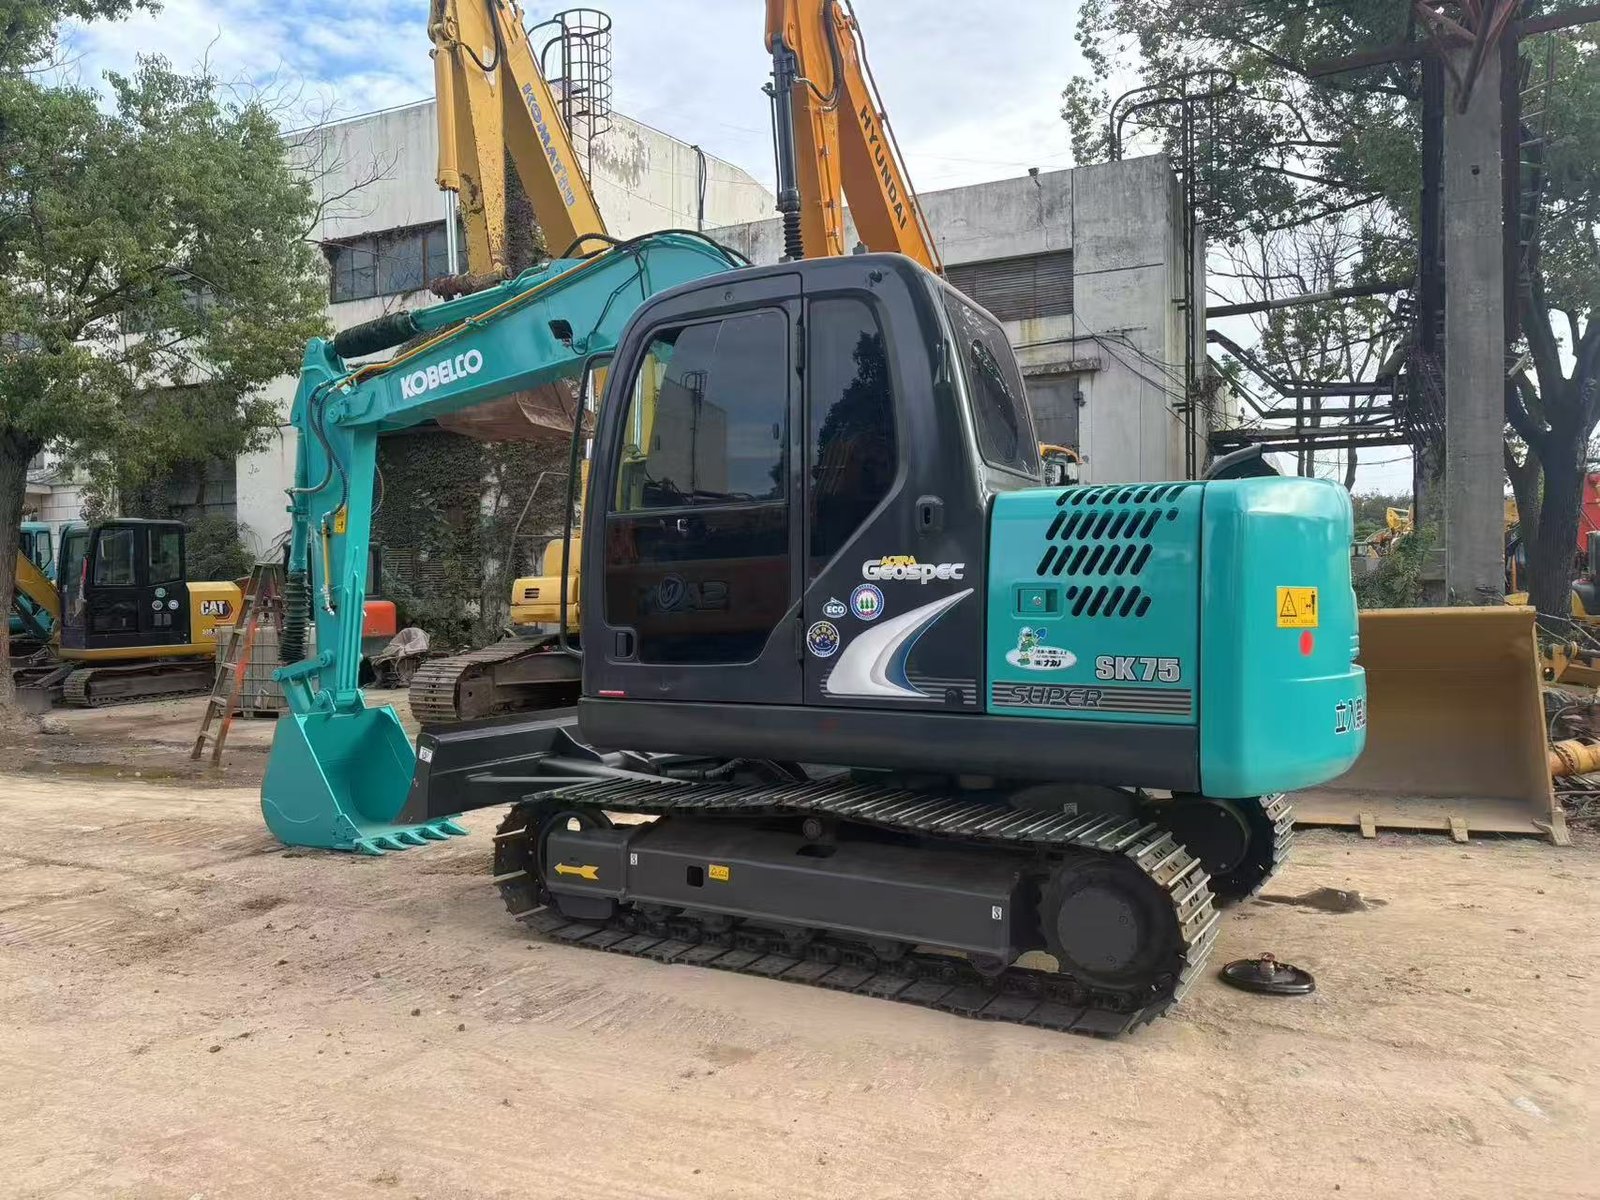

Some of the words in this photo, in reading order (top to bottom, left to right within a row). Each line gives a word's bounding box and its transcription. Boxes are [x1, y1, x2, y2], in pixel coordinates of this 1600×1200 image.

[860, 105, 907, 230] HYUNDAI
[400, 349, 483, 400] KOBELCO
[201, 600, 226, 615] CAT
[826, 606, 844, 614] ECO
[1094, 654, 1181, 683] SK75
[1011, 686, 1103, 707] SUPER
